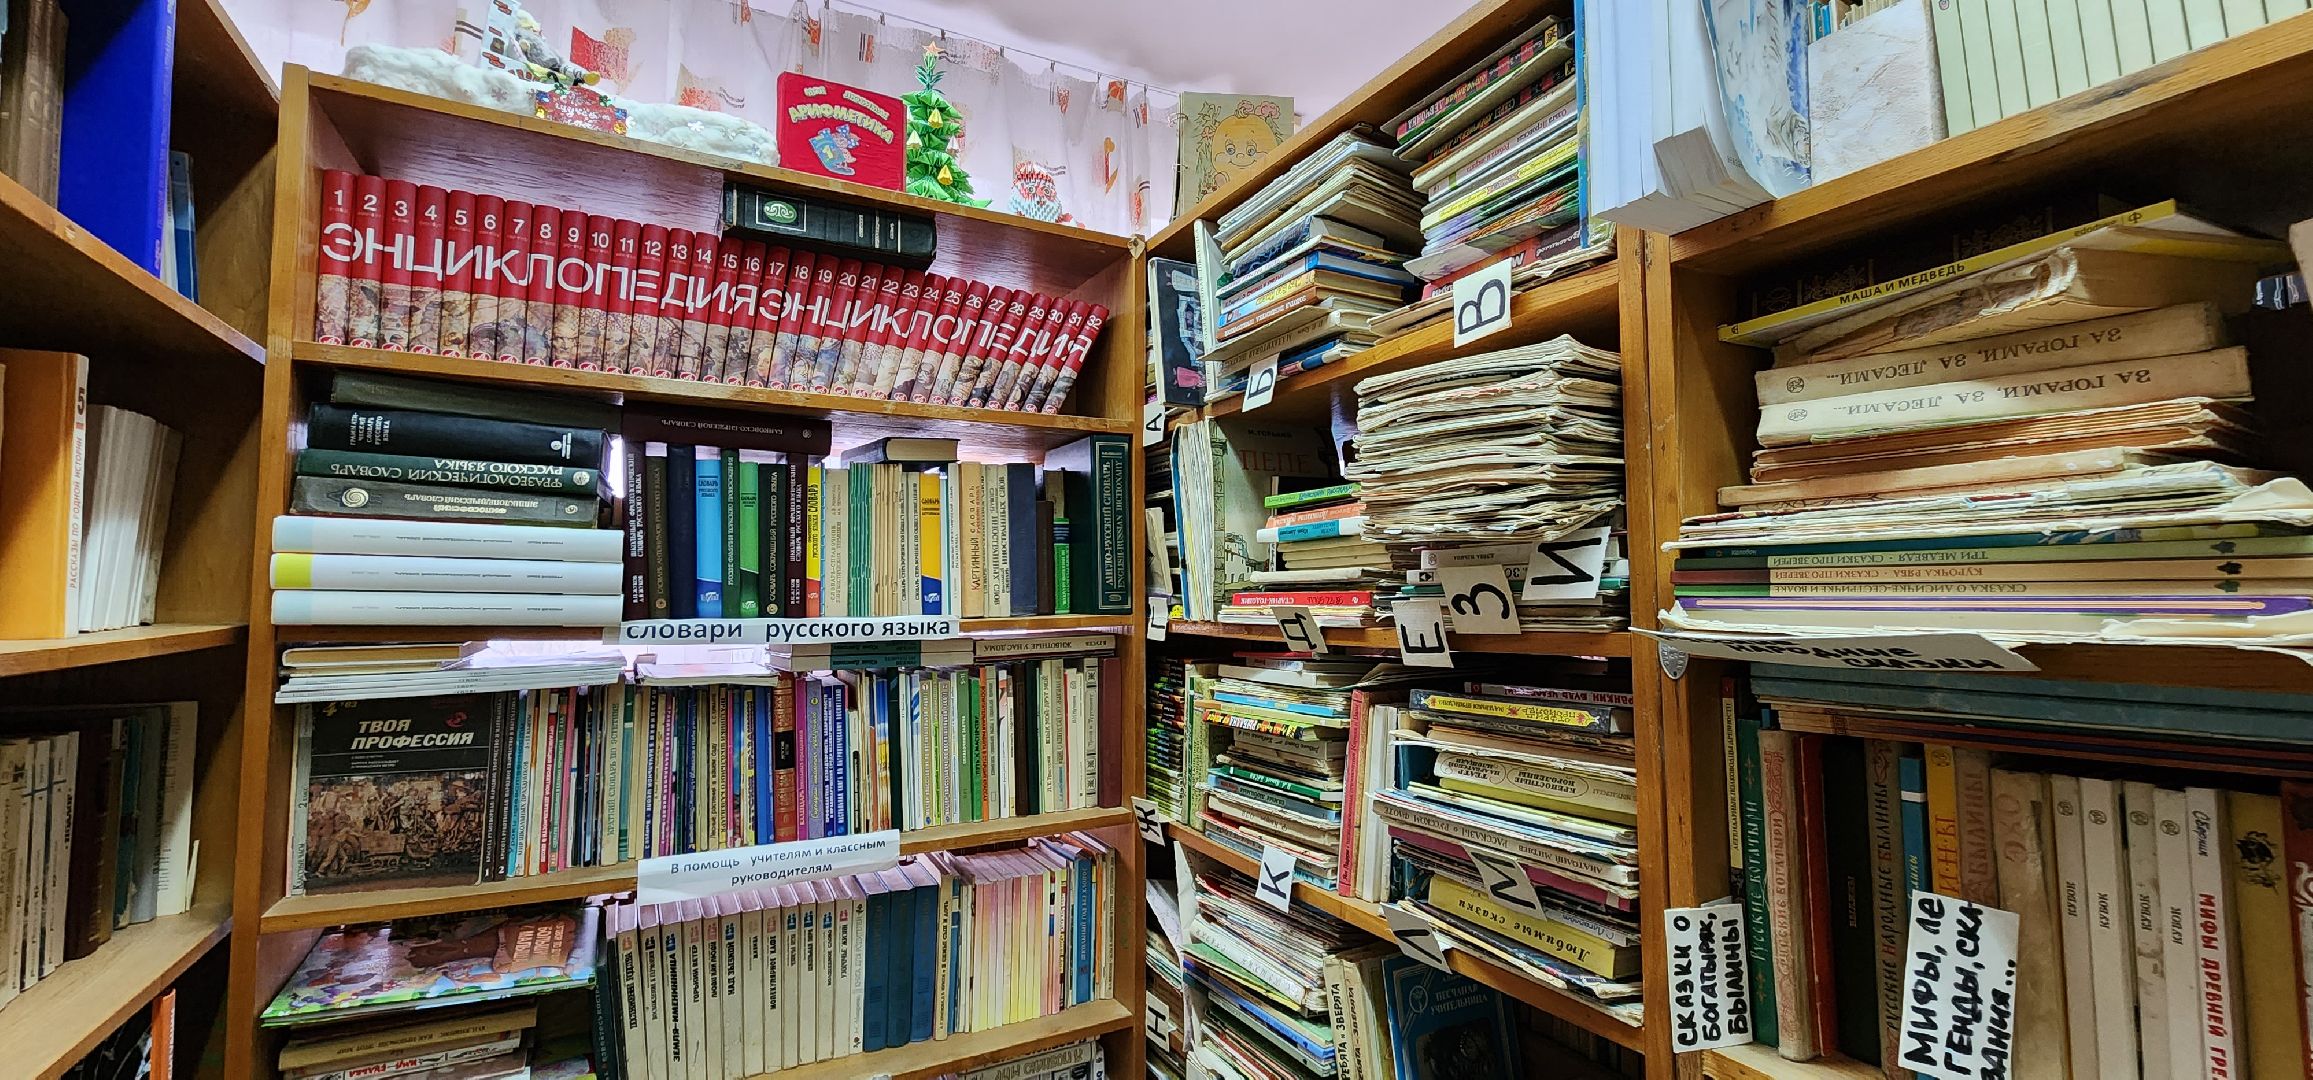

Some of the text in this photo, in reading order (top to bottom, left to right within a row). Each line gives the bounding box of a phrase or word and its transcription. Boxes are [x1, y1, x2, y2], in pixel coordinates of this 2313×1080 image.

[788, 104, 894, 145] АРИФМЕТИКА
[335, 190, 343, 205] 1
[364, 195, 377, 211] 2
[396, 201, 408, 217] 3
[425, 205, 438, 220] 4
[455, 210, 468, 225] 5
[484, 215, 497, 230] 6
[513, 219, 525, 233] 7
[540, 223, 552, 239] 8
[569, 228, 580, 242] 9
[592, 233, 608, 248] 10
[620, 239, 634, 253] 11
[644, 241, 661, 256] 12
[671, 245, 687, 260] 13
[696, 249, 712, 264] 14
[722, 254, 738, 269] 15
[745, 257, 761, 272] 16
[769, 262, 785, 276] 17
[794, 265, 809, 280] 18
[818, 269, 833, 284] 19
[840, 273, 857, 287] 20
[861, 276, 877, 290] 21
[882, 280, 899, 295] 22
[1840, 264, 1965, 305] МАША И МЕДВЕДЬ
[902, 283, 919, 298] 23
[923, 287, 939, 301] 24
[944, 291, 961, 305] 25
[966, 294, 982, 309] 26
[988, 298, 1006, 312] 27
[1009, 302, 1025, 316] 28
[1457, 278, 1506, 337] В
[1028, 306, 1045, 320] 29
[1047, 309, 1063, 324] 30
[1067, 313, 1081, 326] 31
[1086, 315, 1102, 329] 32
[1827, 328, 2121, 386] ЗА ГОРАМИ, ЗА ЛЕСАМИ...
[1247, 366, 1274, 400] Б
[2113, 369, 2151, 385] ЗА
[1997, 376, 2104, 399] ГОРАМИ,
[1955, 391, 1984, 404] ЗА
[330, 463, 562, 488] ФРАЗЕОЛОГИЧЕСКИЙ СЛОВАРЬ
[433, 459, 562, 476] РУССКОГО ЯЗЫКА
[807, 484, 819, 512] СЛОВАРЬ
[69, 437, 82, 589] РАССКАЗЫ ПО РОДНОЙ ИСТОРИИ
[1101, 461, 1114, 585] АНГЛО-РУССКИЙ СЛОВАРЬ
[1114, 461, 1125, 588] ENGLISH-RUSSIAN DICTIONARY
[999, 502, 1008, 565] ИНОСТРАННЫХ
[969, 537, 981, 591] КАРТИННЫЙ
[991, 516, 1001, 605] ИНОСТРАННЫХ СЛОВ
[1773, 550, 1988, 567] ТРИ МЕДВЕДЯ СКАЗКИ ПРО ЗВЕРЕЙ
[1775, 566, 1983, 580] КУРОЧКА РЯБА СКАЗКИ ПРО ЗВЕРЕЙ
[1774, 585, 1808, 593] ВОЛКЕ
[1819, 583, 1952, 593] ЛИСИЧКЕ-СЕСТРИЧКЕ
[1957, 584, 1966, 592] О
[1969, 583, 2027, 593] СКАЗКА
[626, 617, 951, 642] словари русского языка
[984, 643, 1006, 651] ДОМА
[1007, 642, 1022, 650] НАС
[1030, 641, 1072, 651] ЖИВОТНЫЕ
[1722, 644, 1923, 658] НАРОДНЫЕ
[1844, 656, 2005, 670] СКАЗКИ
[358, 719, 411, 734] ТВОЯ
[350, 732, 475, 750] ПРОФЕССИЯ
[610, 749, 617, 759] ПО
[608, 761, 617, 797] СЛОВАРЬ
[1457, 769, 1488, 780] ТЕАТР
[1517, 771, 1576, 787] КОРОЛЕВНЫ
[1514, 776, 1577, 795] КРЕПОСТНЫЕ
[607, 799, 616, 834] КРАТКИЙ
[1383, 807, 1603, 875] АНАТОЛИЙ МИТЯЕВ РАССКАЗЫ РУССКОМ ФЛОТЕ
[670, 840, 886, 875] В помощь учителям и классным
[1771, 817, 1786, 895] БОГАТЫРИ
[732, 864, 832, 886] руководителям
[1746, 799, 1769, 961] РУССКИЕ БОГАТЫРИ
[1260, 869, 1290, 900] К
[1873, 780, 1902, 1031] РУССКИЕ НАРОДНЫЕ БЫЛИНЫ
[2066, 882, 2077, 917] КУБОК
[2098, 893, 2110, 929] КУБОК
[2140, 895, 2152, 931] КУБОК
[1458, 899, 1591, 963] Любимые сказки
[2171, 907, 2183, 945] КУБОК
[2198, 893, 2224, 1037] МИФЫ ДРЕВНЕЙ
[769, 958, 777, 1010] МОЛЕКУЛЯРНОЕ
[1674, 915, 1697, 1047] СКАЗКИ О
[1721, 918, 1748, 1034] БЫЛИНЫ
[692, 968, 700, 1002] ГОРЬКИЙ
[1434, 985, 1478, 1002] ПЕСЧАНАЯ
[1348, 987, 1359, 1036] ЗВЕРЯТА
[1430, 993, 1489, 1016] УЧИТЕЛЬНИЦА
[1331, 983, 1352, 1080] РЕБЯТА ЗВЕРЯТА
